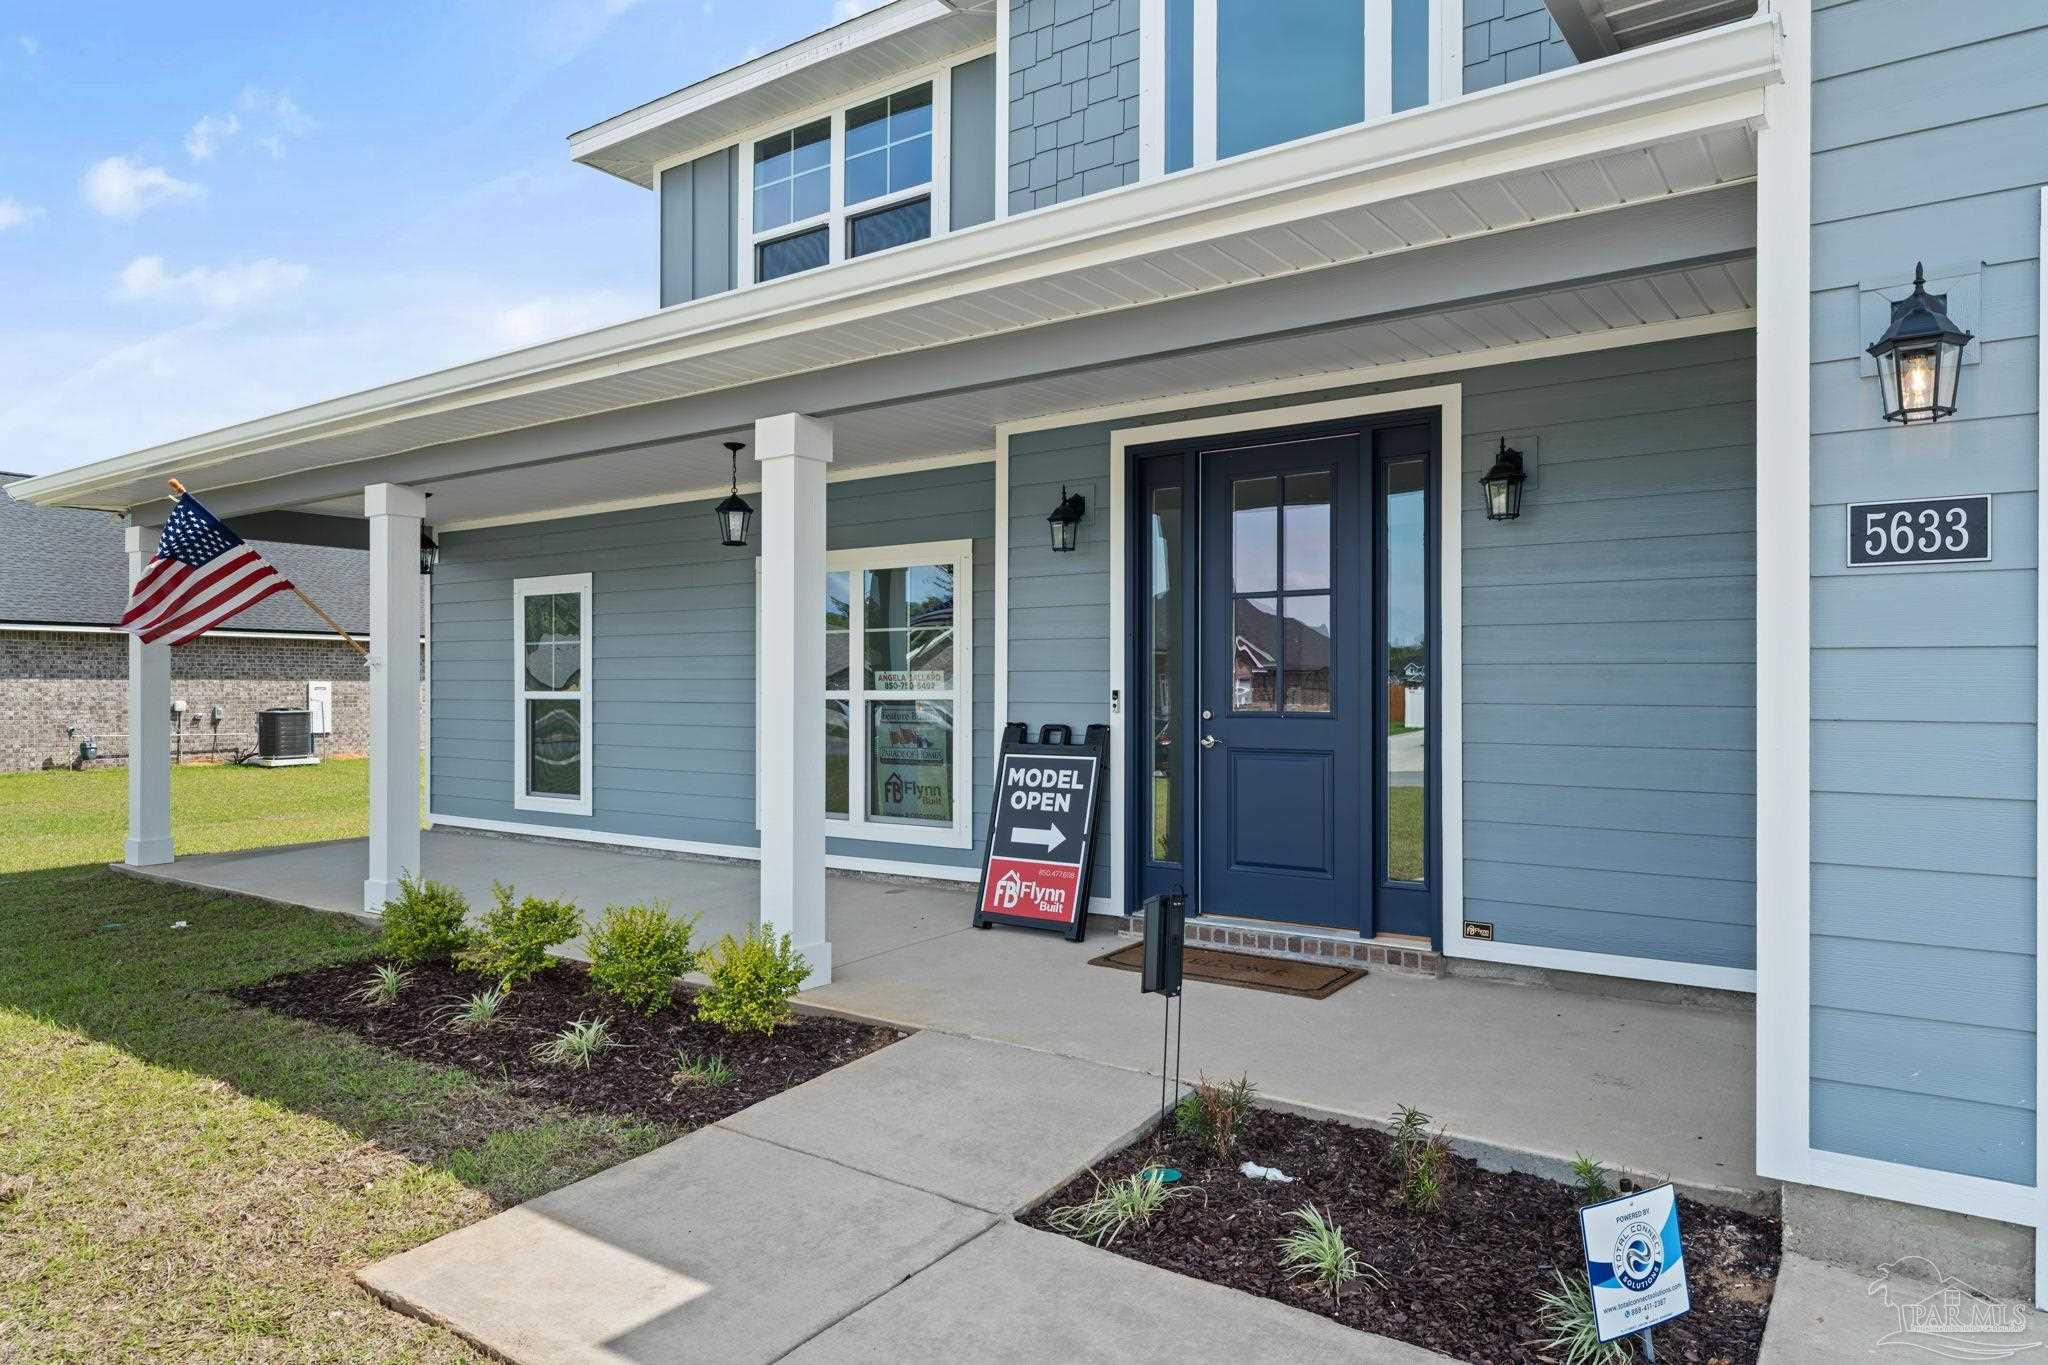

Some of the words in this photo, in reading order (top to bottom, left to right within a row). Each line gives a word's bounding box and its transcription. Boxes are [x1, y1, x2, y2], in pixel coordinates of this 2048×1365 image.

[1864, 507, 1970, 556] 5633
[878, 673, 906, 682] ANGELA
[904, 781, 942, 798] Flynn
[1007, 767, 1084, 790] MODEL
[1010, 790, 1071, 813] OPEN
[1020, 881, 1065, 905] Flynn
[1039, 902, 1064, 914] Built
[1615, 1210, 1642, 1223] POWERED
[1642, 1207, 1650, 1216] BY
[1616, 1232, 1630, 1270] TOTAL
[1630, 1224, 1661, 1258] CONNECT
[1622, 1265, 1659, 1289] SOLUTIONS
